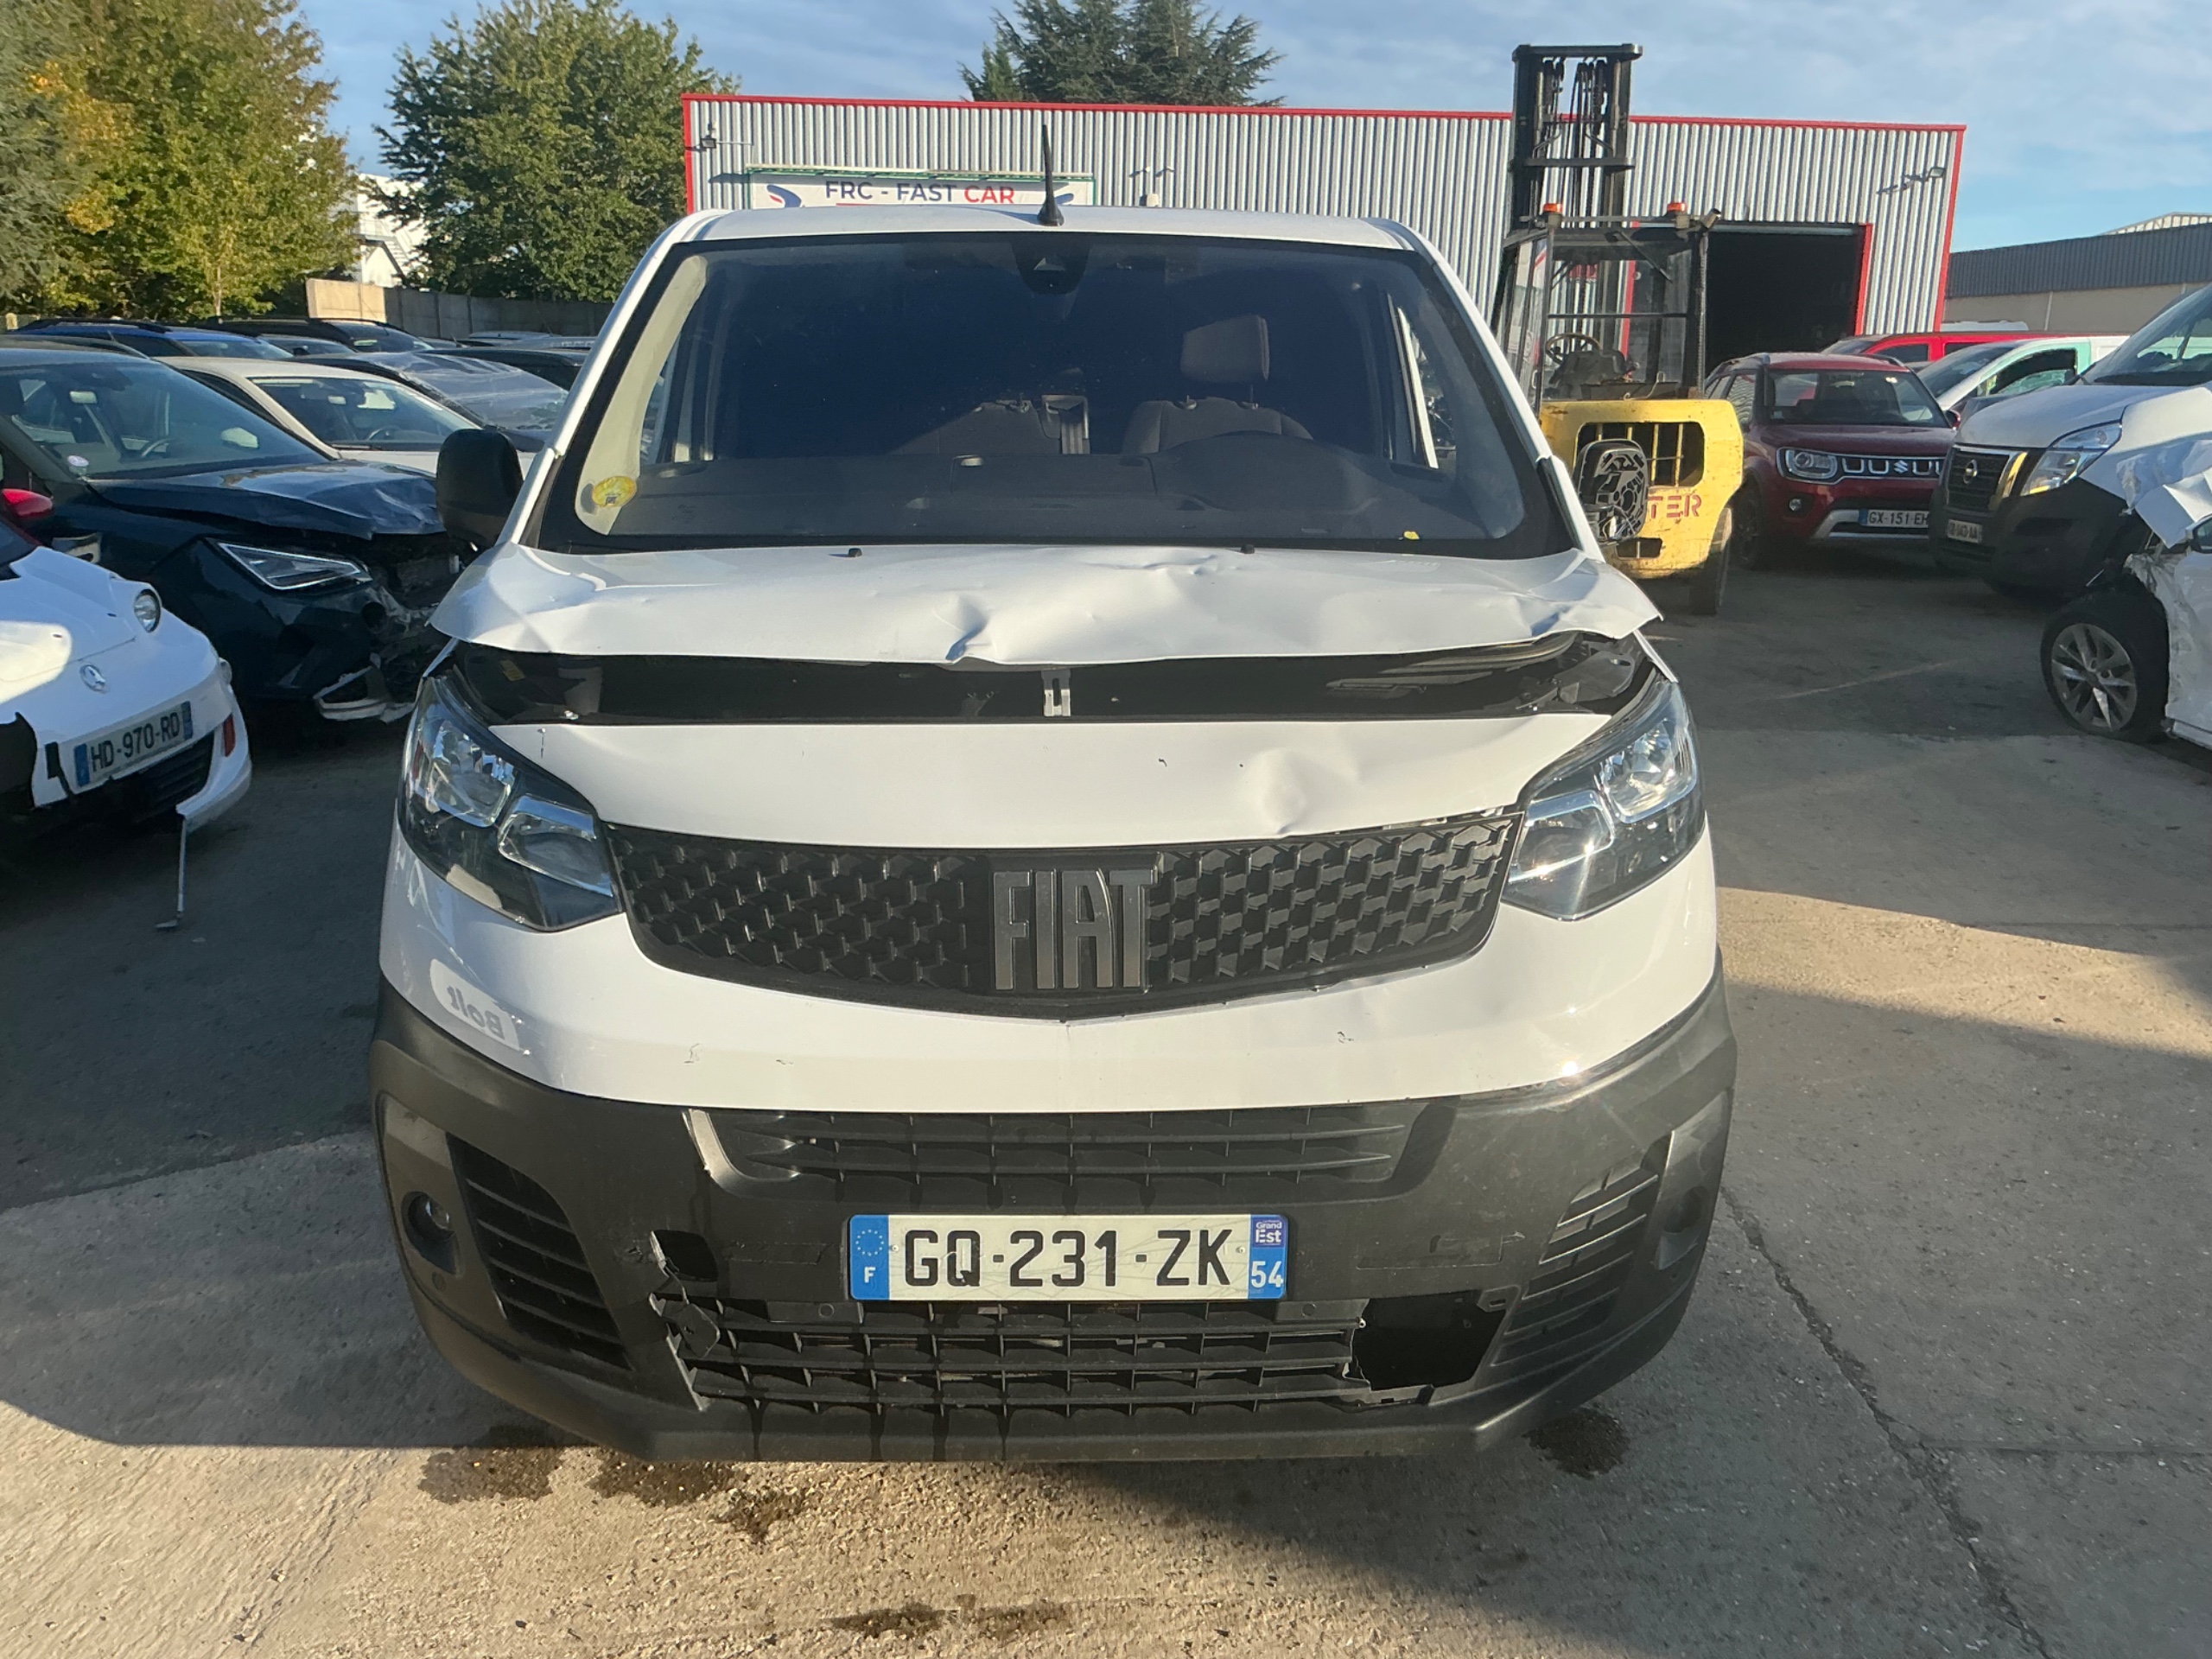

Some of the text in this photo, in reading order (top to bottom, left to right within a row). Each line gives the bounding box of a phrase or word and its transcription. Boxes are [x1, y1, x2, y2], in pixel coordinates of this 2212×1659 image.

[825, 180, 874, 200] FRC
[896, 182, 957, 203] FAST
[963, 185, 1015, 205] CAR
[1647, 494, 1702, 518] TER
[90, 711, 181, 772] HD-970-RD
[994, 868, 1157, 991] FIAT
[1255, 1221, 1282, 1230] Grand
[1255, 1229, 1282, 1243] Est
[904, 1229, 1233, 1287] GQ-231-ZK
[862, 1266, 877, 1284] F
[1250, 1260, 1285, 1289] 54
